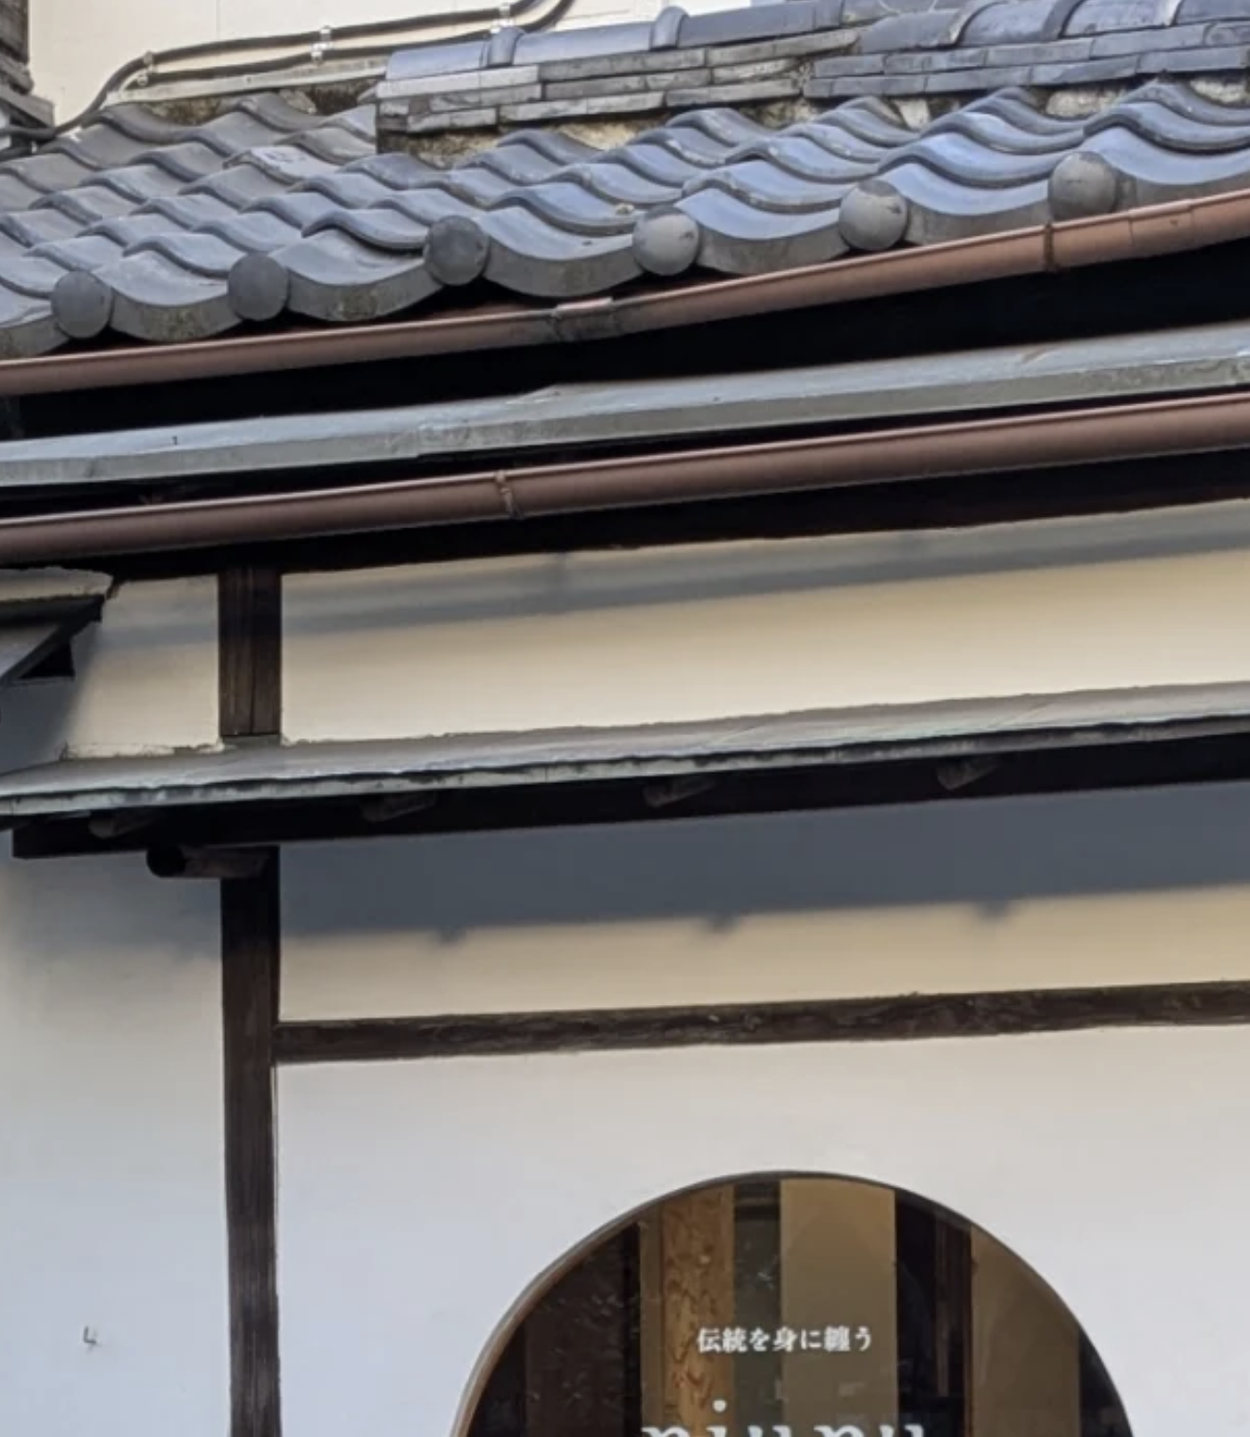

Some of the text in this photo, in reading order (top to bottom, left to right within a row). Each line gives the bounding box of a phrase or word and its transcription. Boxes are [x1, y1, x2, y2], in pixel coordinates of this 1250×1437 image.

[697, 1325, 872, 1353] 伝統を身に纏う
